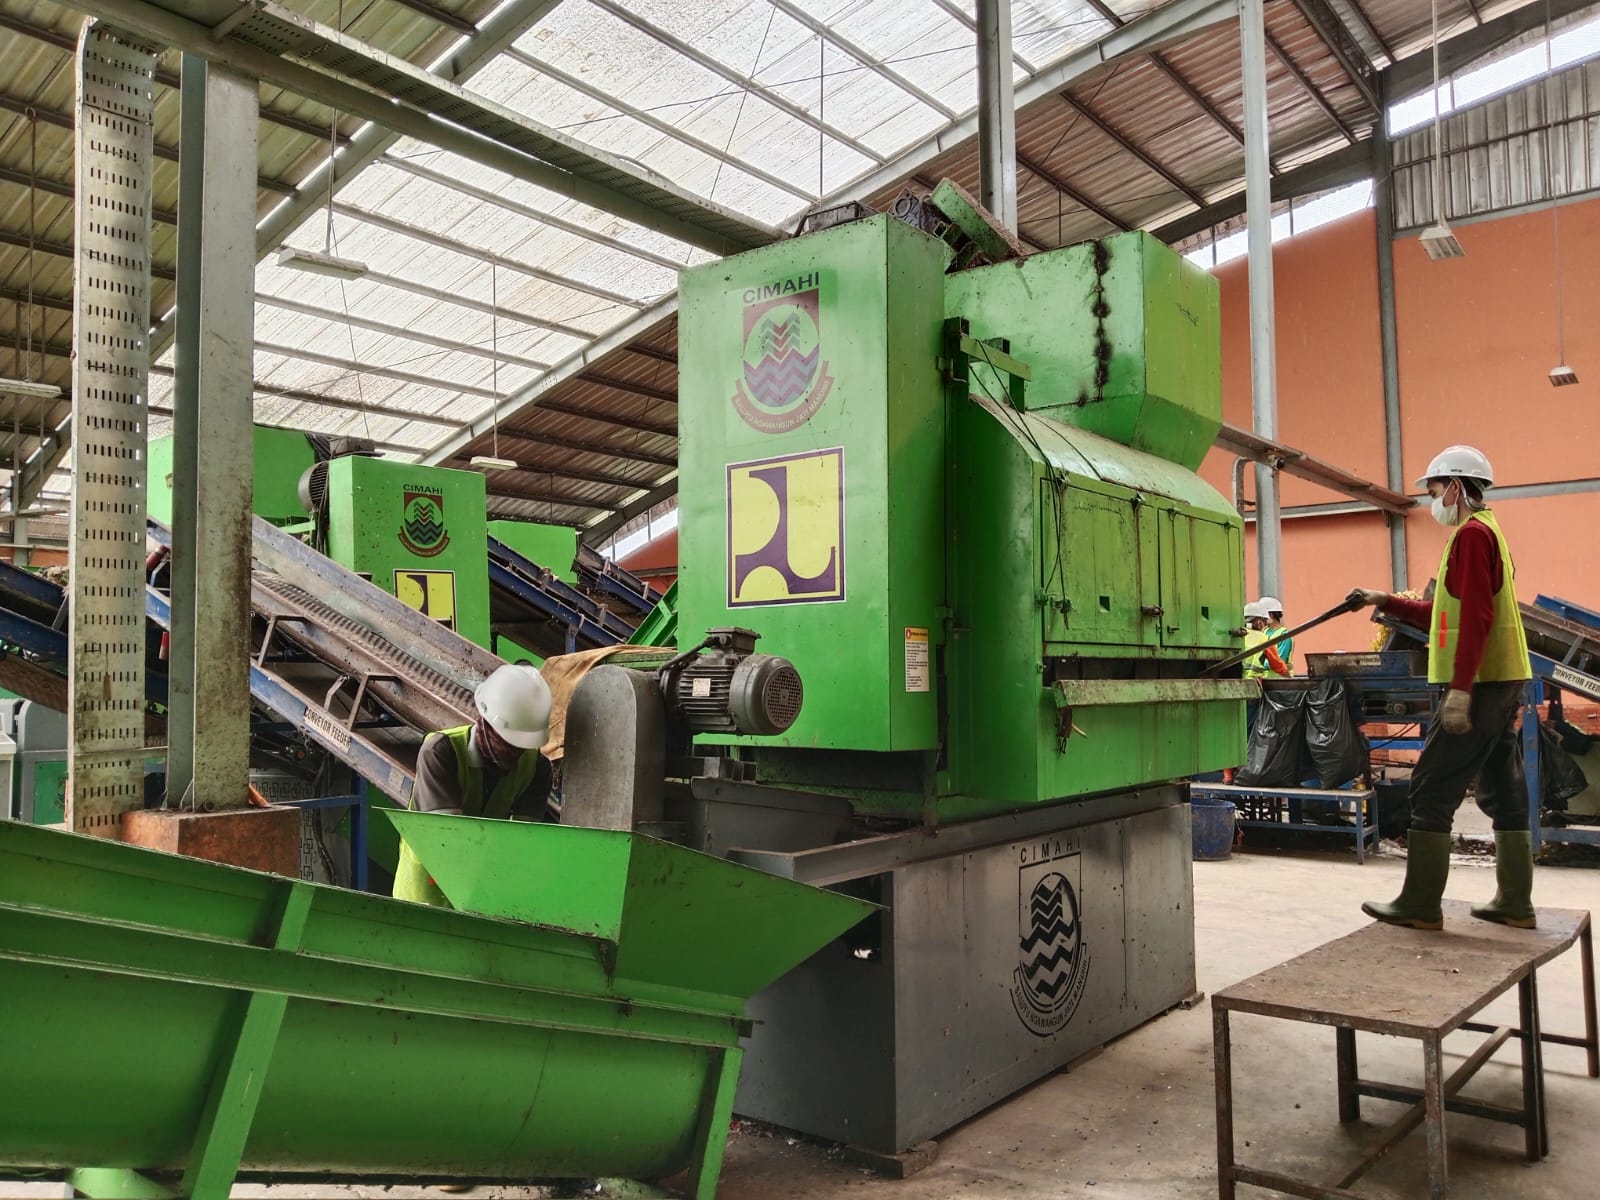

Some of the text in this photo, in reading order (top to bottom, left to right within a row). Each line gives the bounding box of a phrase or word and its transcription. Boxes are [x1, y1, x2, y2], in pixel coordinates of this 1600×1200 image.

[743, 272, 819, 304] CIMAHI
[403, 484, 443, 494] CIMAHI
[331, 726, 351, 747] FEEDER
[1020, 835, 1080, 863] CIMAHI
